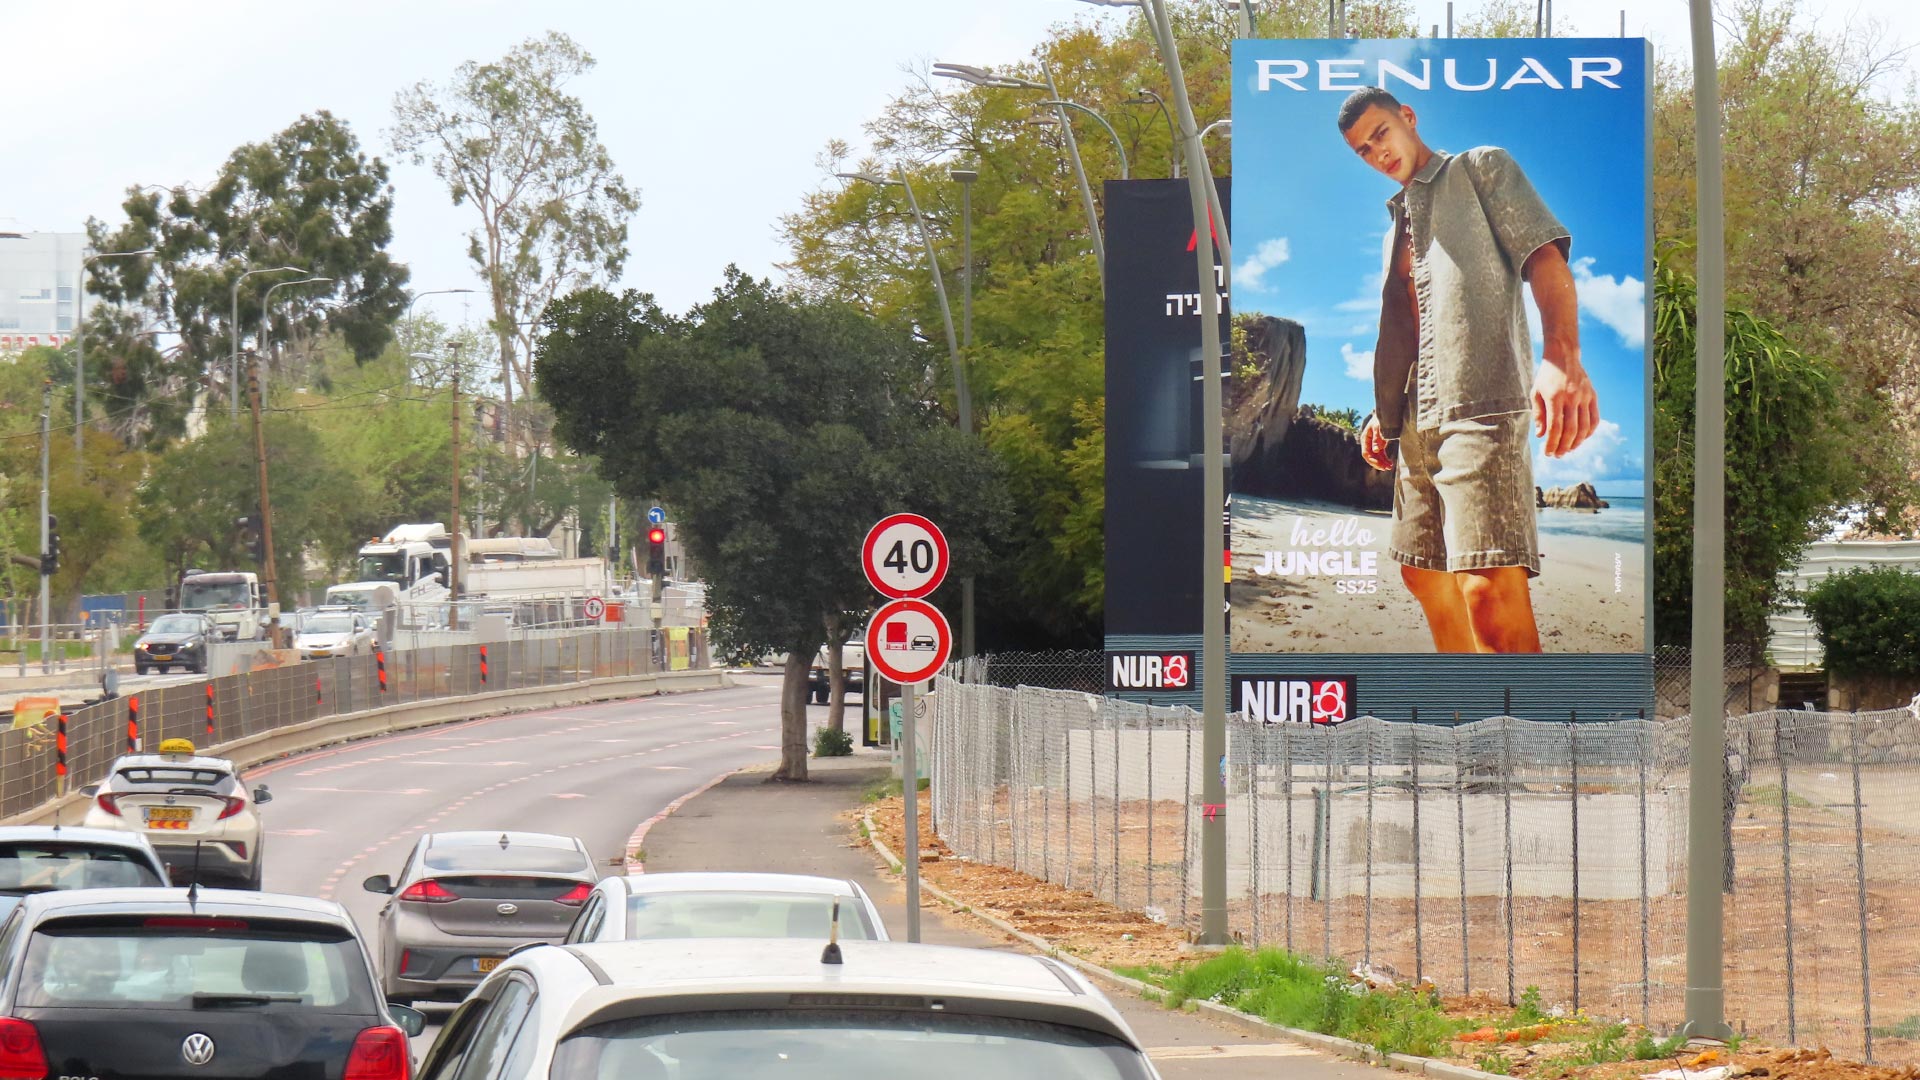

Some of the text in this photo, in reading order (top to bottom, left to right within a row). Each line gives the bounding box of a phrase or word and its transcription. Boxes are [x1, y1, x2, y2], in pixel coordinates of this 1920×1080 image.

[1254, 57, 1623, 91] RENUAR
[1289, 516, 1377, 547] hello
[883, 539, 934, 574] 40
[1253, 550, 1378, 576] JUNGLE
[1335, 580, 1377, 595] SS25
